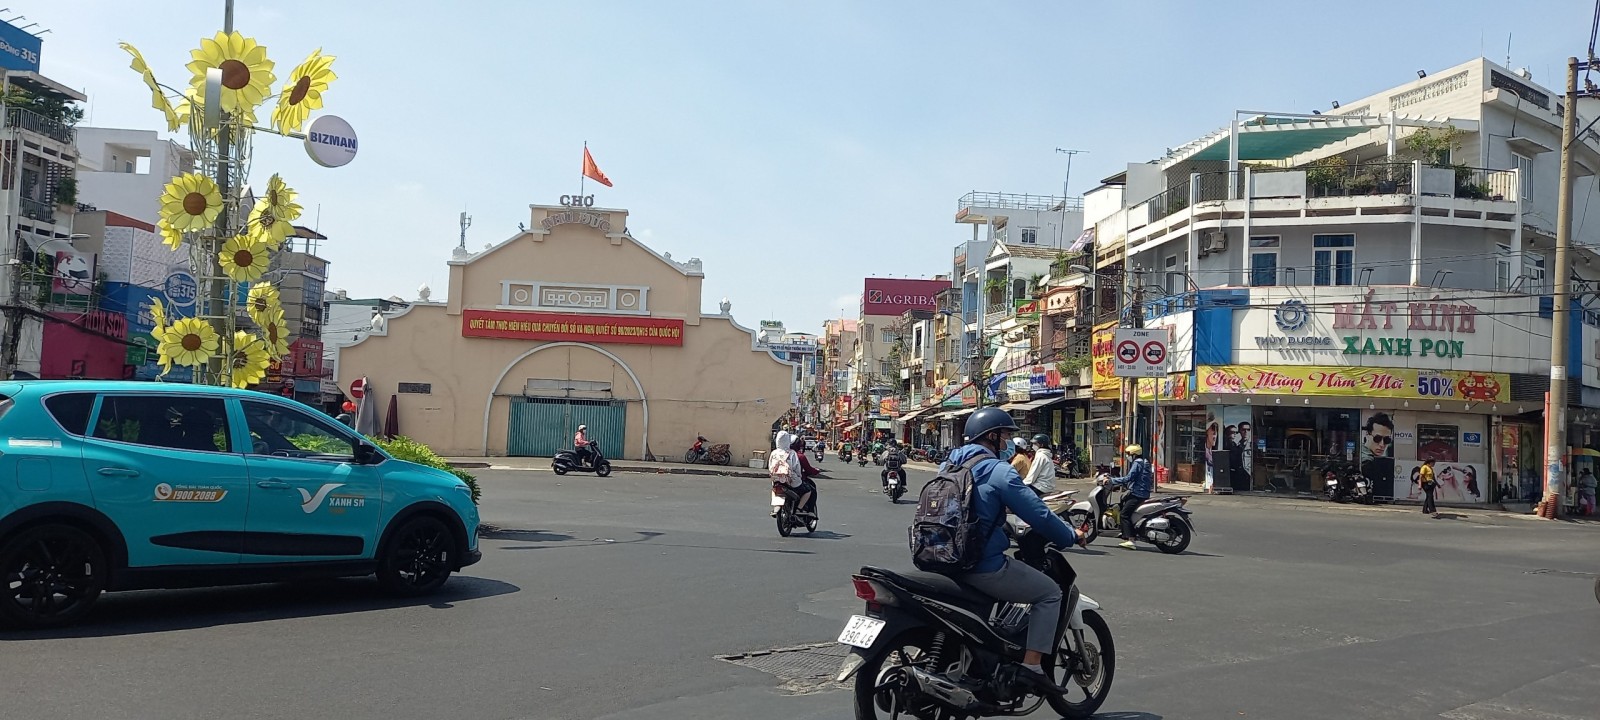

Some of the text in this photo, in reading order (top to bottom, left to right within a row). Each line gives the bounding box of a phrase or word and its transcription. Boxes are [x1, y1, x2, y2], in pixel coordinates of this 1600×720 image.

[20, 47, 37, 64] 315
[310, 131, 356, 149] BIZMAN
[181, 285, 197, 300] 315
[884, 294, 937, 306] AGRIBA
[1333, 288, 1476, 333] MẮT KÍNH
[1342, 336, 1464, 359] XANH PON
[1418, 376, 1454, 397] 50%
[173, 490, 216, 500] 1900 2088
[329, 497, 365, 507] XANH SM
